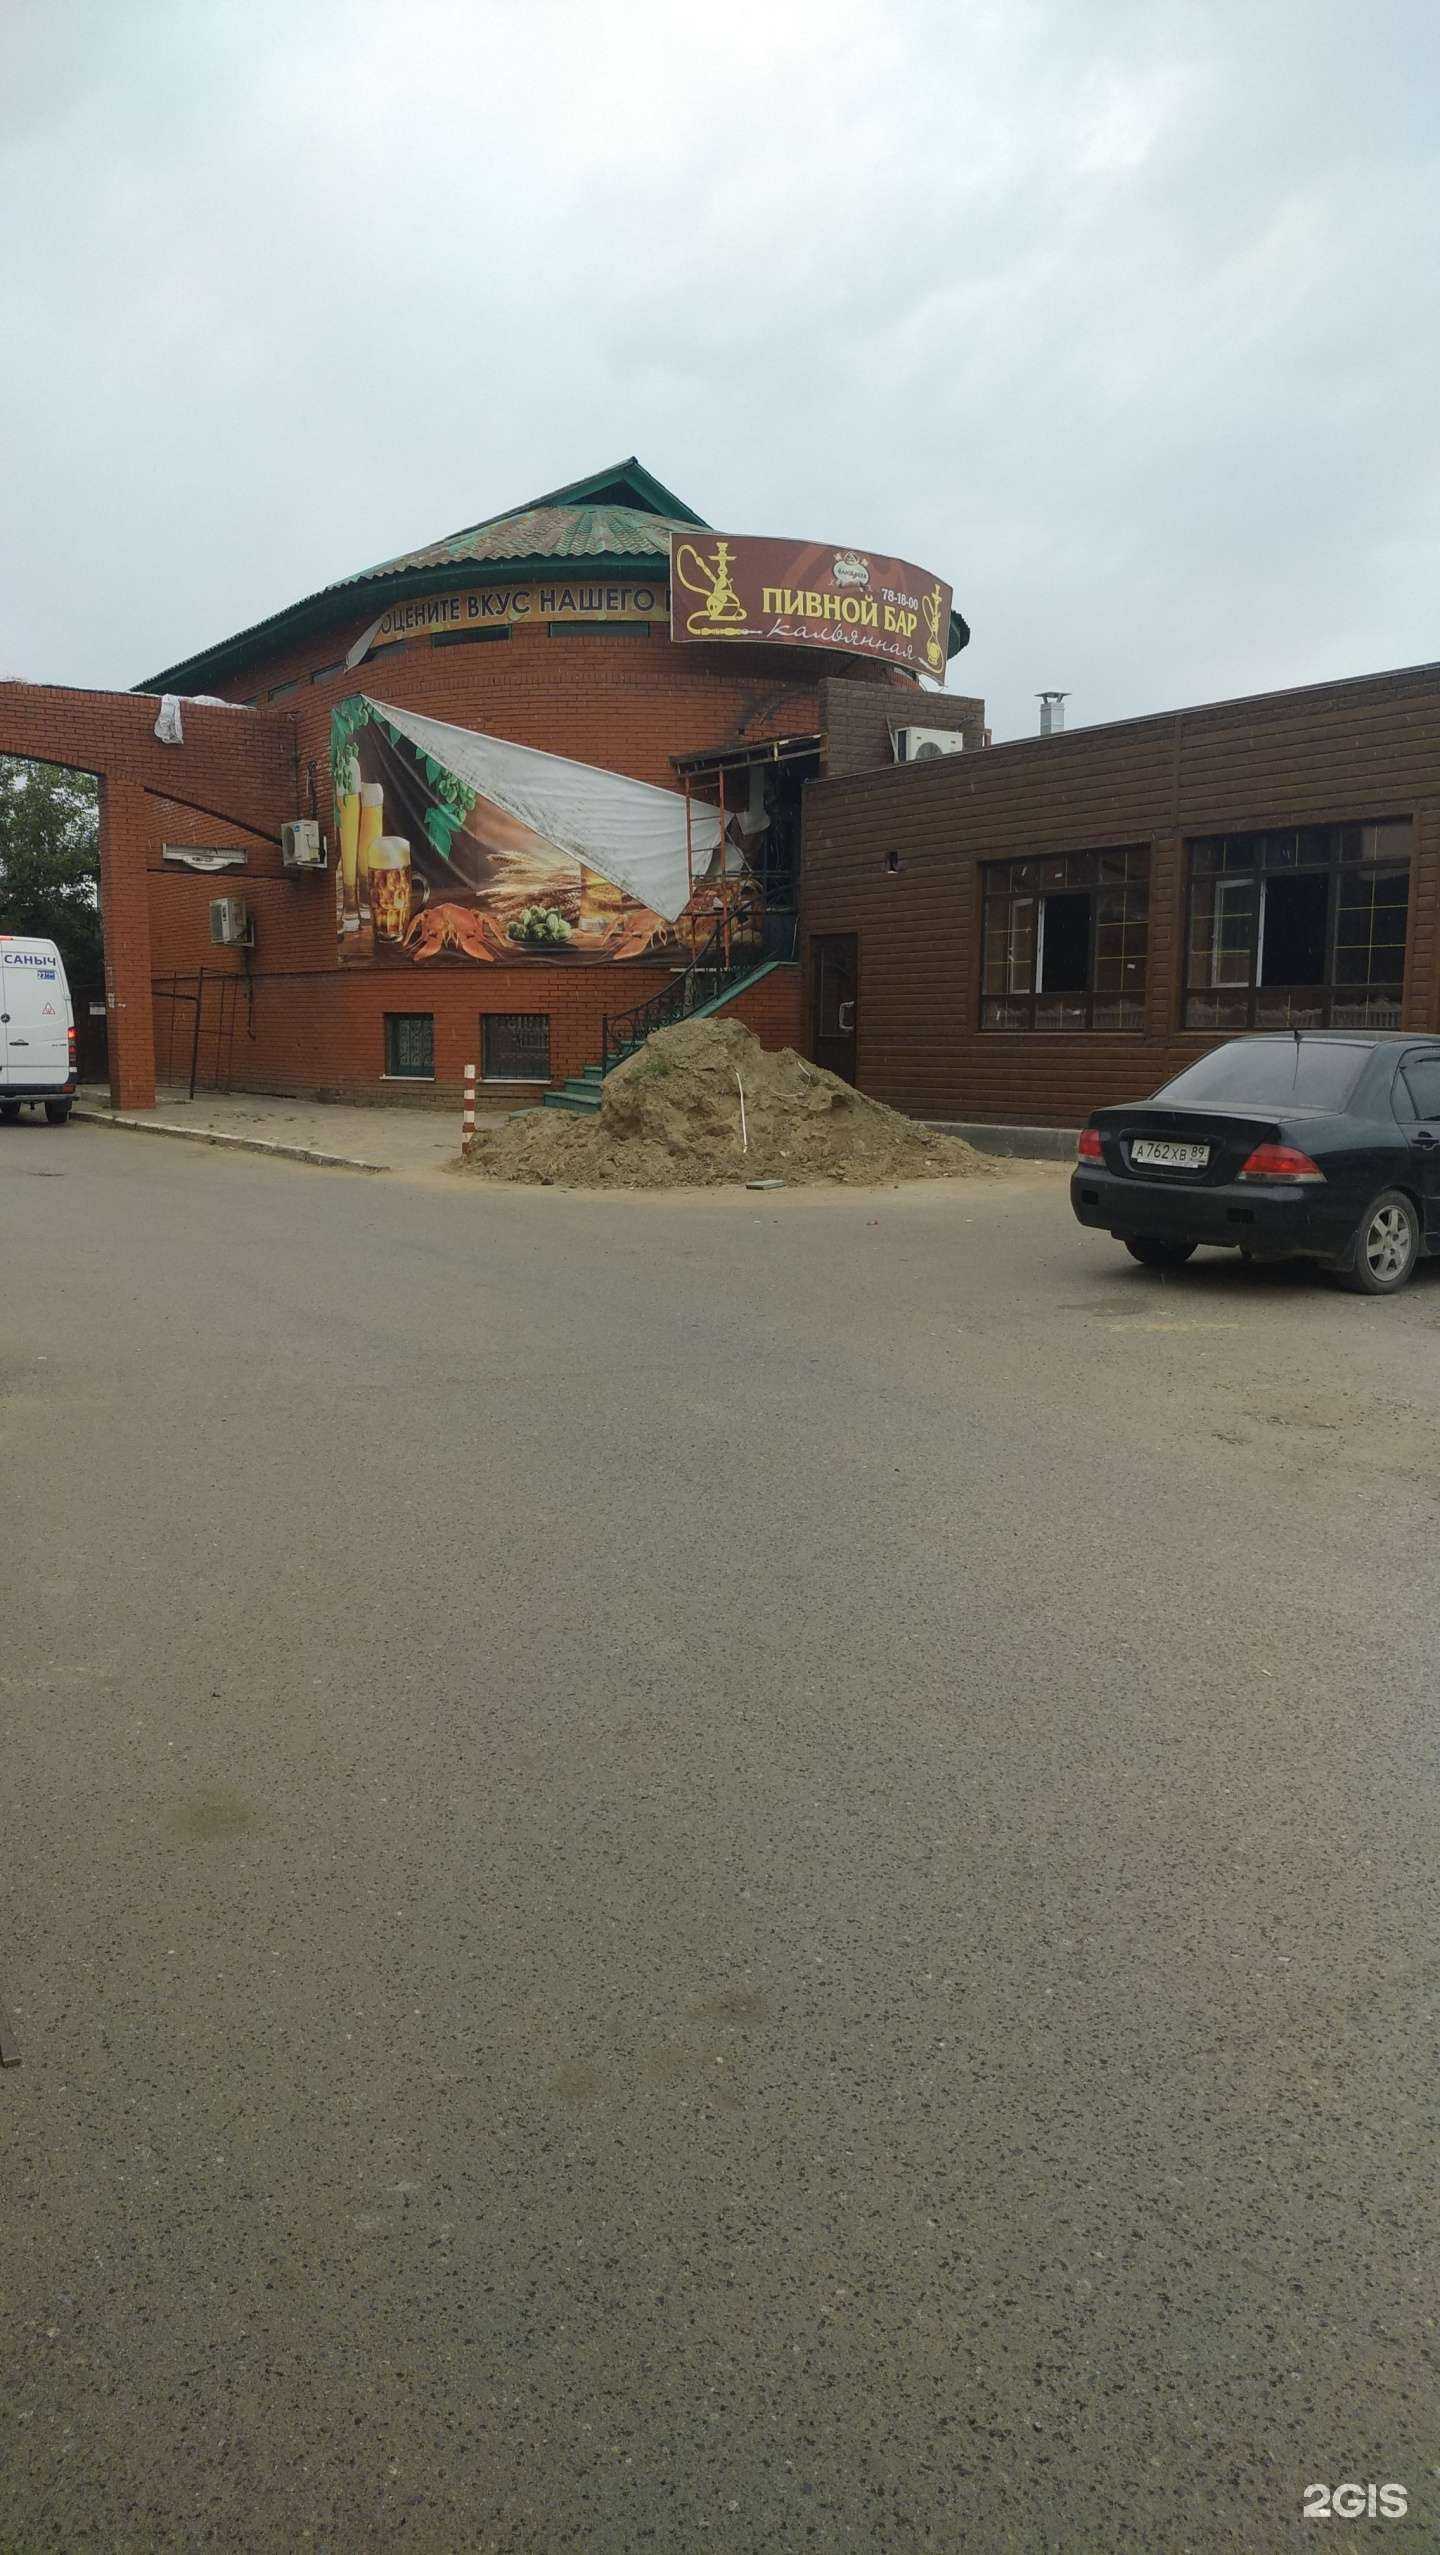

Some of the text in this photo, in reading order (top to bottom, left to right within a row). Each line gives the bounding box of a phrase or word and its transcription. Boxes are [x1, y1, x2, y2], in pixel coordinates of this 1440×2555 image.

[380, 598, 460, 634] ОЦЕНИТЕ
[466, 590, 531, 618] ВКУС
[540, 588, 655, 612] НАШЕГО
[762, 587, 917, 637] ПИВНОЙ БАР
[4, 954, 56, 966] САНЫЧ
[1191, 1146, 1205, 1158] 89
